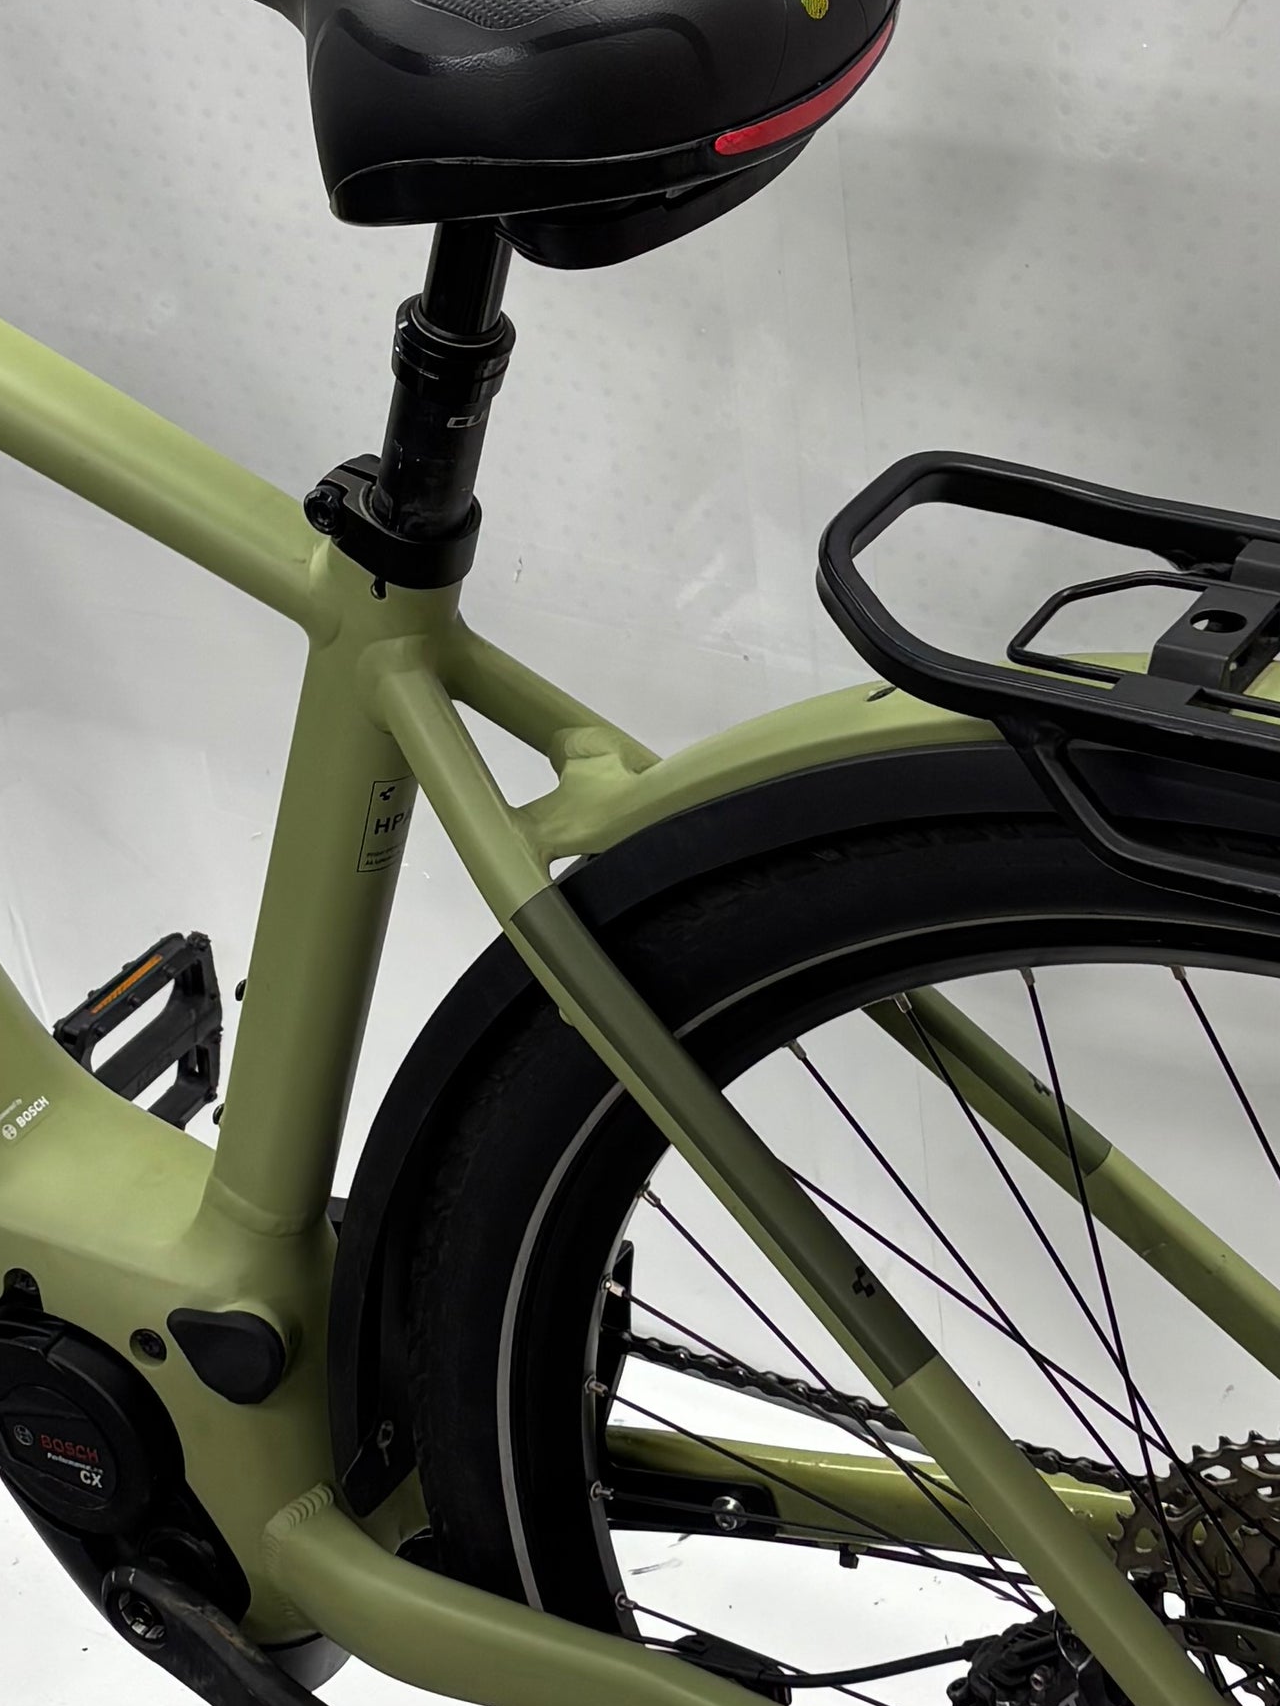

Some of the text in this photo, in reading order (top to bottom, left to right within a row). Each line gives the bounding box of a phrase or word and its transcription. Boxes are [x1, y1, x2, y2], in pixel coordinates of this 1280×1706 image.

[16, 1095, 50, 1129] BOSCH
[40, 1434, 100, 1464] BOSCH
[80, 1469, 103, 1489] CX
